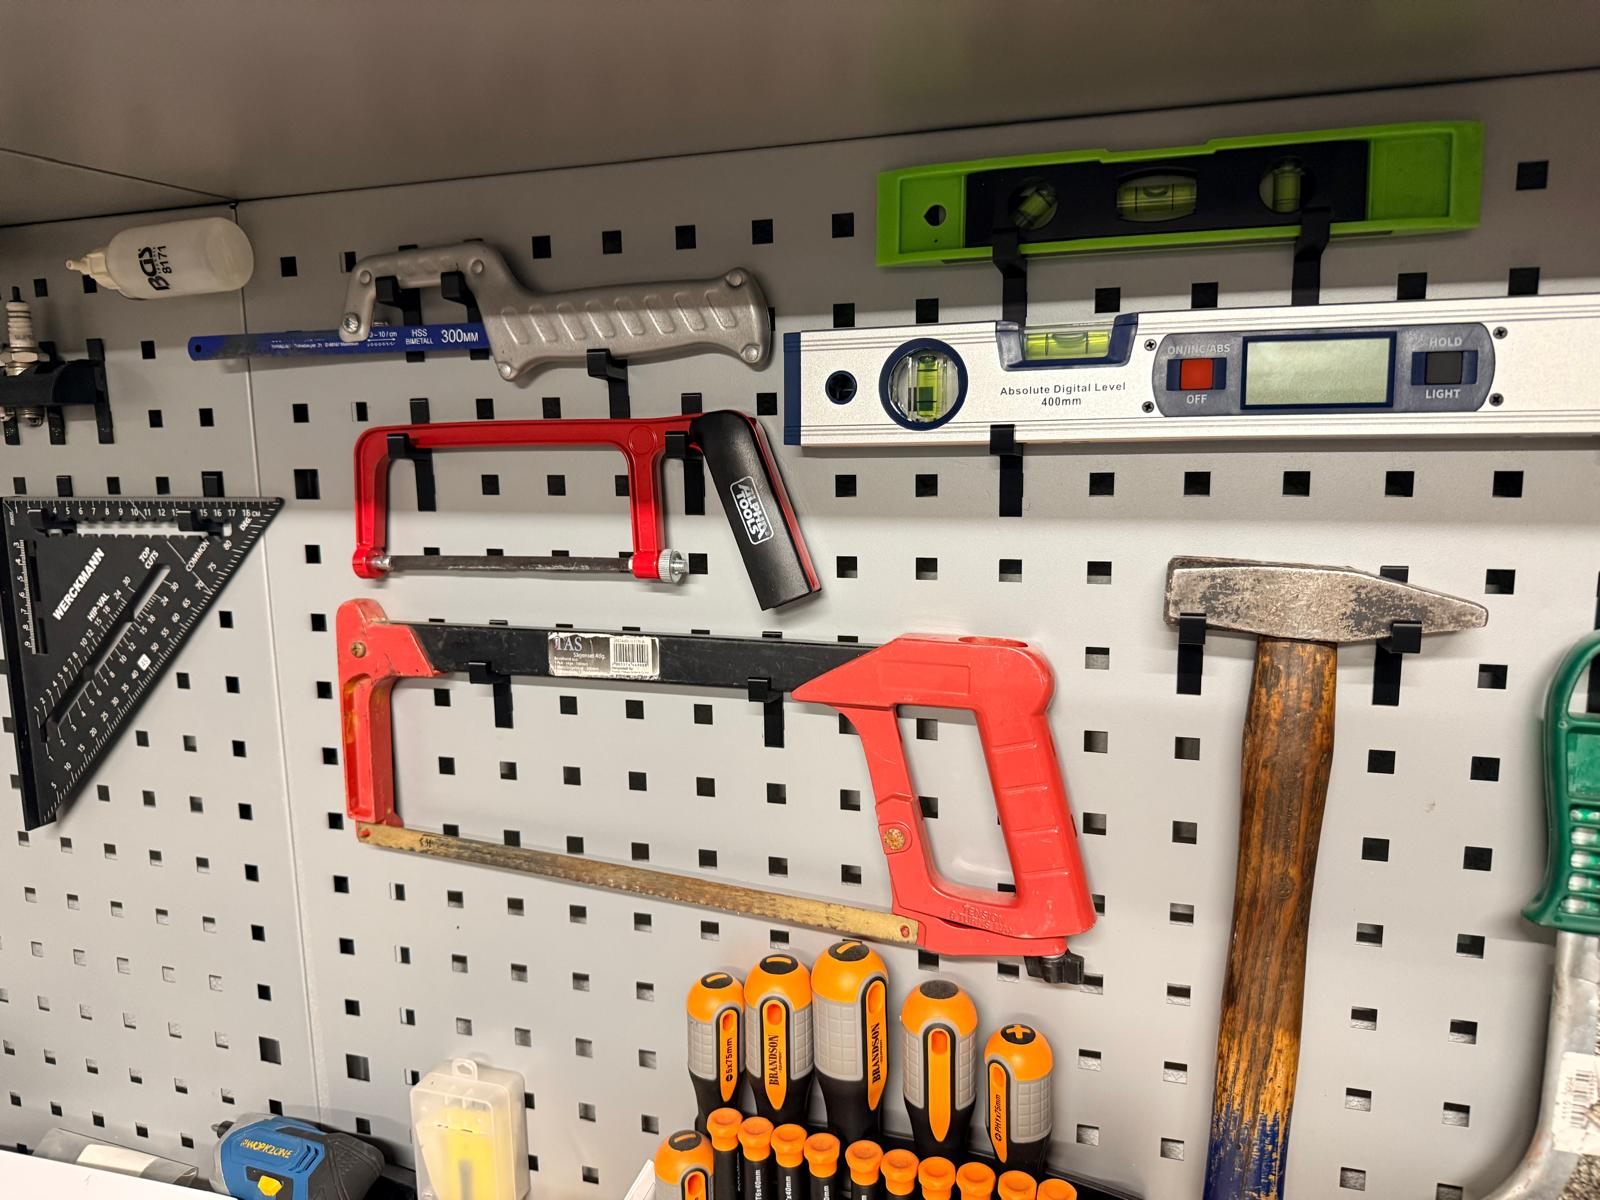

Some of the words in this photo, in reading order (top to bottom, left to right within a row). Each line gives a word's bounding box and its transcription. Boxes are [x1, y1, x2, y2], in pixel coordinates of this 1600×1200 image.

[157, 246, 172, 274] 8171
[405, 337, 434, 345] BIMETALL
[411, 328, 428, 337] HSS
[441, 329, 479, 343] 300MM
[1429, 336, 1462, 347] HOLD
[1167, 343, 1231, 355] ON/INC/ABS
[1000, 385, 1050, 396] Absolute
[1053, 383, 1091, 395] Digital
[1094, 381, 1126, 392] Level
[1041, 397, 1082, 407] 400mm
[1186, 394, 1208, 404] OFF
[1425, 389, 1461, 399] LIGHT
[736, 490, 758, 535] TOOLS
[738, 484, 767, 540] ALPHA
[139, 546, 150, 562] TOP
[144, 550, 159, 569] CUTS
[185, 539, 210, 572] COMMON
[52, 547, 105, 621] WERCKMANN
[80, 637, 87, 647] 10
[86, 629, 94, 638] 12
[94, 617, 102, 626] 15
[102, 605, 111, 614] 18
[114, 589, 122, 599] 24
[123, 576, 131, 586] 30
[87, 592, 110, 622] HIP-VAL
[119, 655, 127, 664] 10
[128, 642, 136, 651] 12
[139, 625, 148, 635] 15
[147, 614, 156, 624] 18
[160, 595, 169, 606] 24
[170, 581, 179, 592] 30
[64, 762, 71, 770] 10
[77, 744, 86, 753] 15
[89, 727, 98, 737] 20
[101, 711, 109, 721] 25
[111, 696, 119, 706] 30
[121, 682, 129, 693] 35
[131, 669, 139, 679] 40
[150, 642, 159, 652] 50
[161, 627, 170, 637] 55
[171, 612, 180, 622] 60
[182, 598, 190, 608] 65
[207, 562, 217, 572] 75
[223, 540, 232, 551] 80
[725, 1038, 733, 1074] 5x75mm
[768, 1034, 779, 1086] BRANDSON
[871, 1022, 882, 1084] BRANDSON
